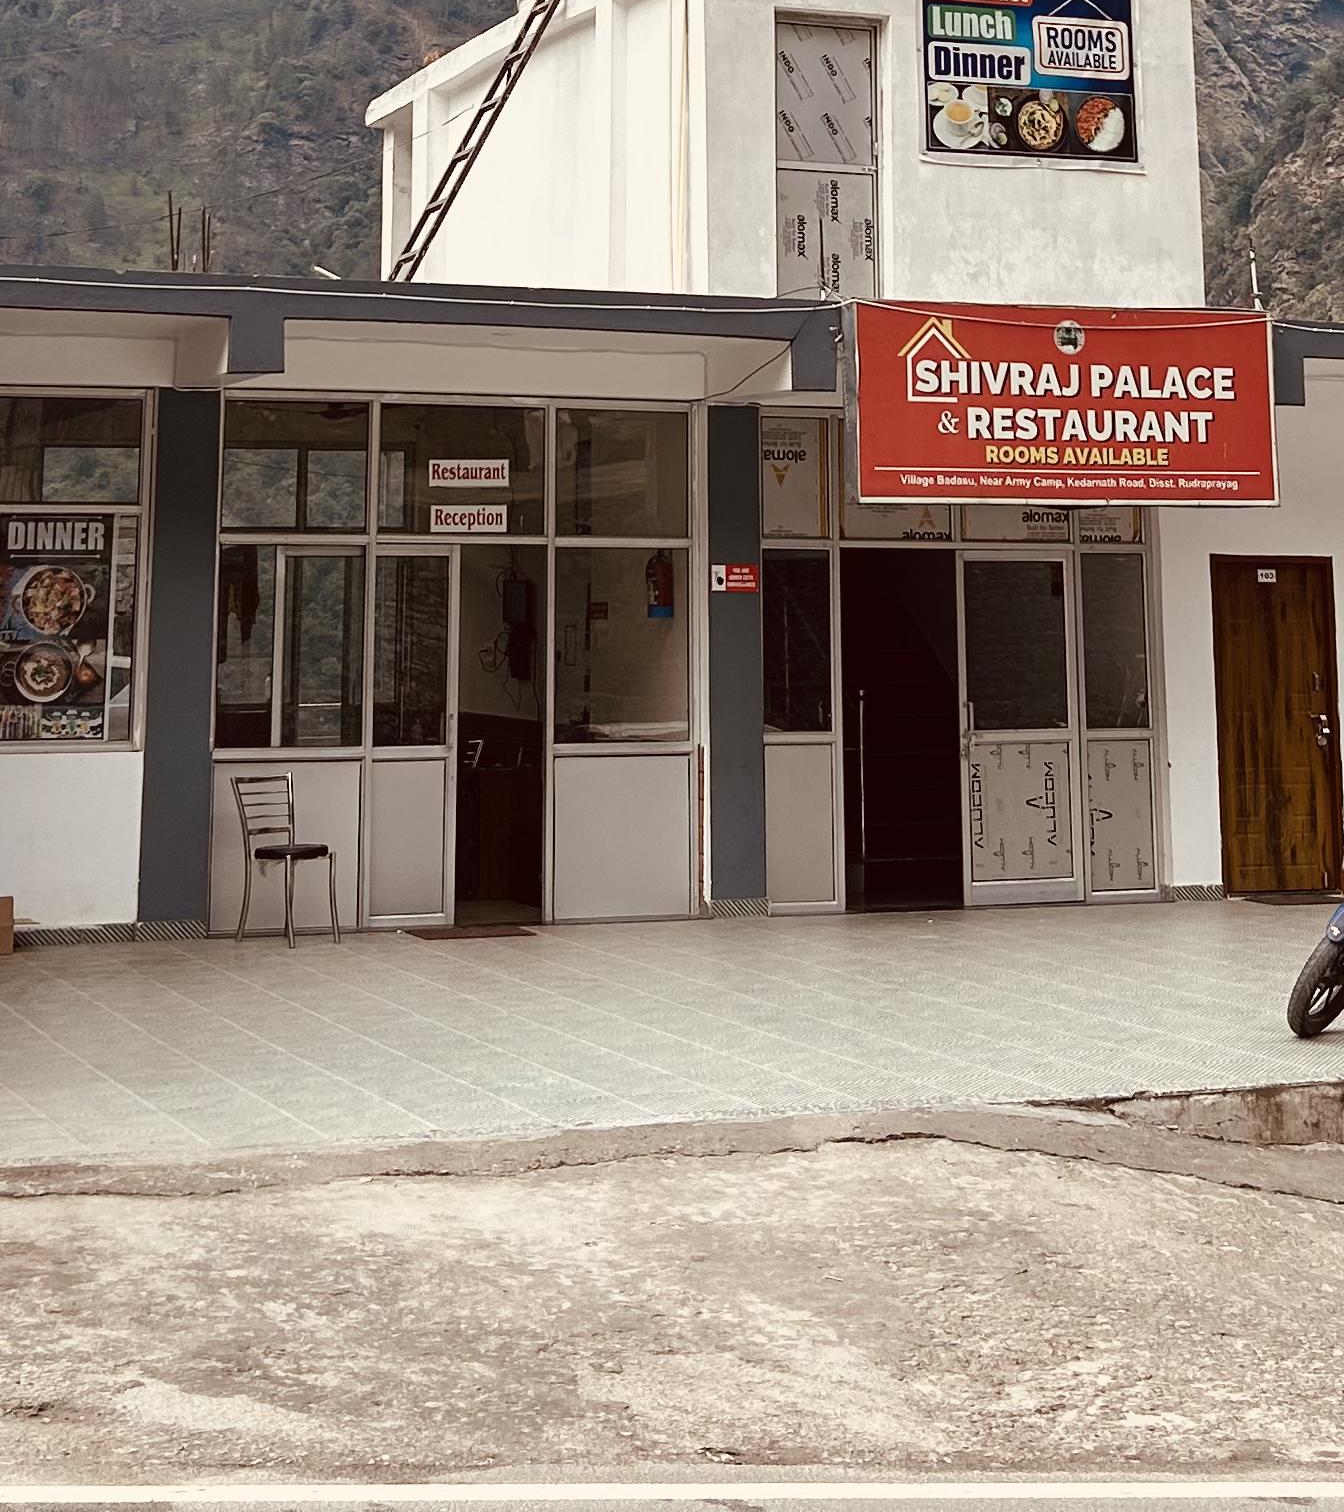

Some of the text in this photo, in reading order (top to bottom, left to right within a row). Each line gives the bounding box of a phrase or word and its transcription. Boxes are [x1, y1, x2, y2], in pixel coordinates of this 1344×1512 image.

[932, 6, 1013, 40] Lunch
[1046, 27, 1116, 53] ROOMS
[778, 50, 794, 73] INDO
[822, 53, 837, 77] INDO
[934, 46, 1025, 81] Dinner
[1048, 51, 1117, 70] AVAILABLE
[779, 110, 795, 133] INDO
[822, 112, 838, 135] INDO
[830, 180, 841, 224] alomax
[797, 214, 808, 260] alomax
[864, 218, 874, 261] alomax
[915, 359, 1235, 400] SHIVRAJ PALACE
[937, 407, 1213, 442] & RESTAURANT
[763, 449, 806, 463] aloma
[986, 445, 1169, 466] ROOMS AVAILABLE
[432, 463, 506, 480] Restaurant
[900, 473, 933, 487] Village
[980, 475, 1003, 486] Near
[1005, 476, 1031, 488] Army
[1067, 477, 1116, 488] Kedarnath
[1178, 478, 1239, 490] Rudraprayag
[434, 507, 503, 530] Reception
[1022, 509, 1069, 523] alomax
[7, 521, 105, 550] DINNER
[971, 763, 984, 849] ALUCOM
[1044, 761, 1057, 847] ALUCOM
